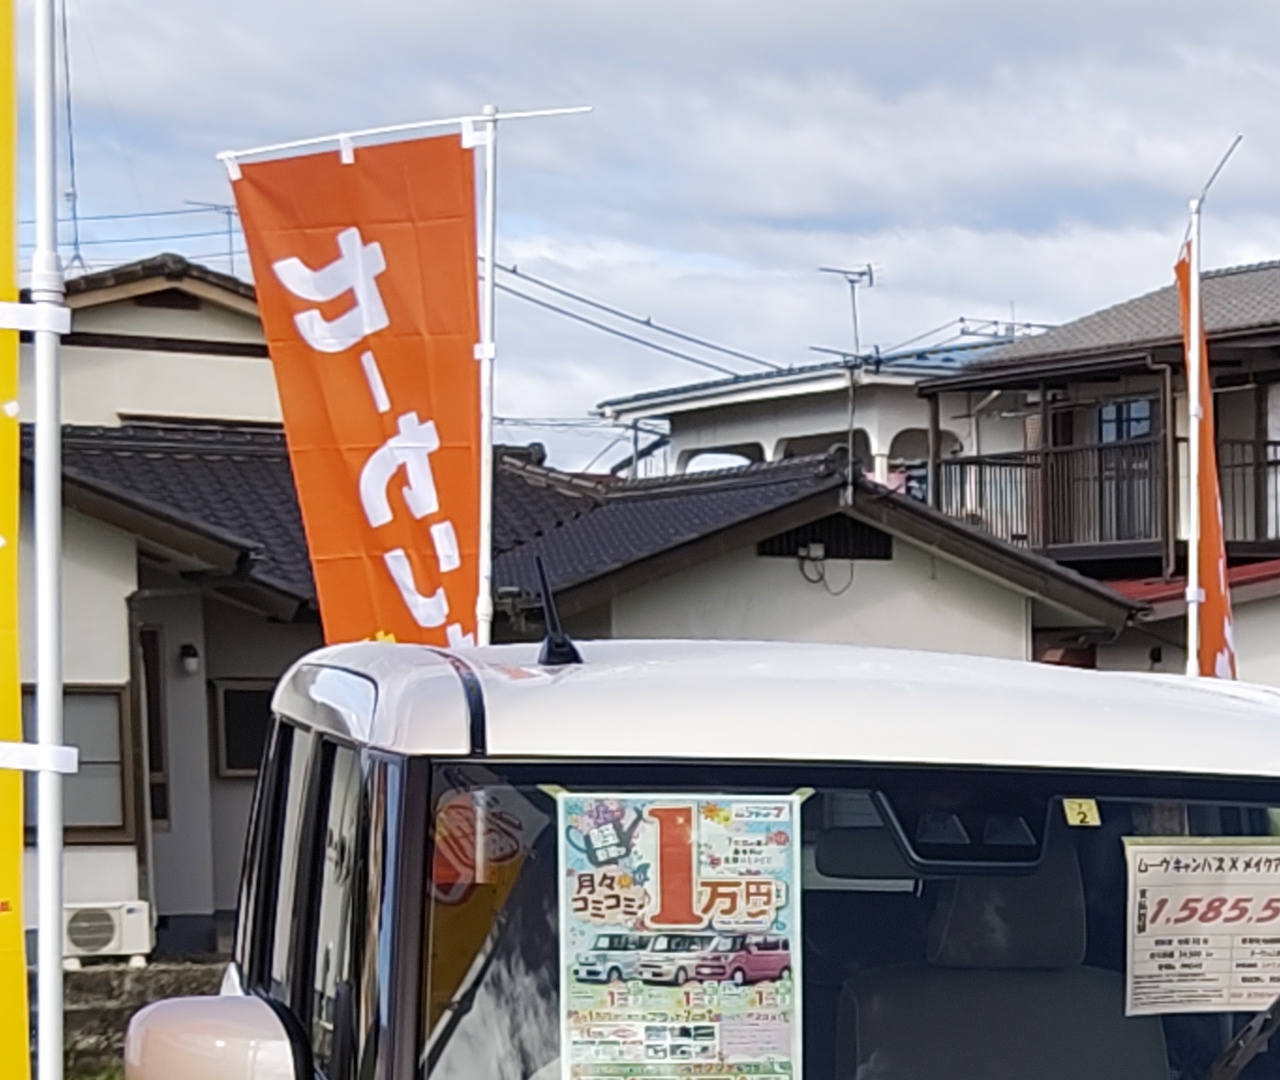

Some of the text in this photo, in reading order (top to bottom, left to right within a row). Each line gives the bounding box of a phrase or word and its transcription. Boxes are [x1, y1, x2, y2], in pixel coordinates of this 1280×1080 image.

[1076, 811, 1090, 824] 2
[576, 872, 617, 895] 月々
[571, 894, 642, 920] コミコミ
